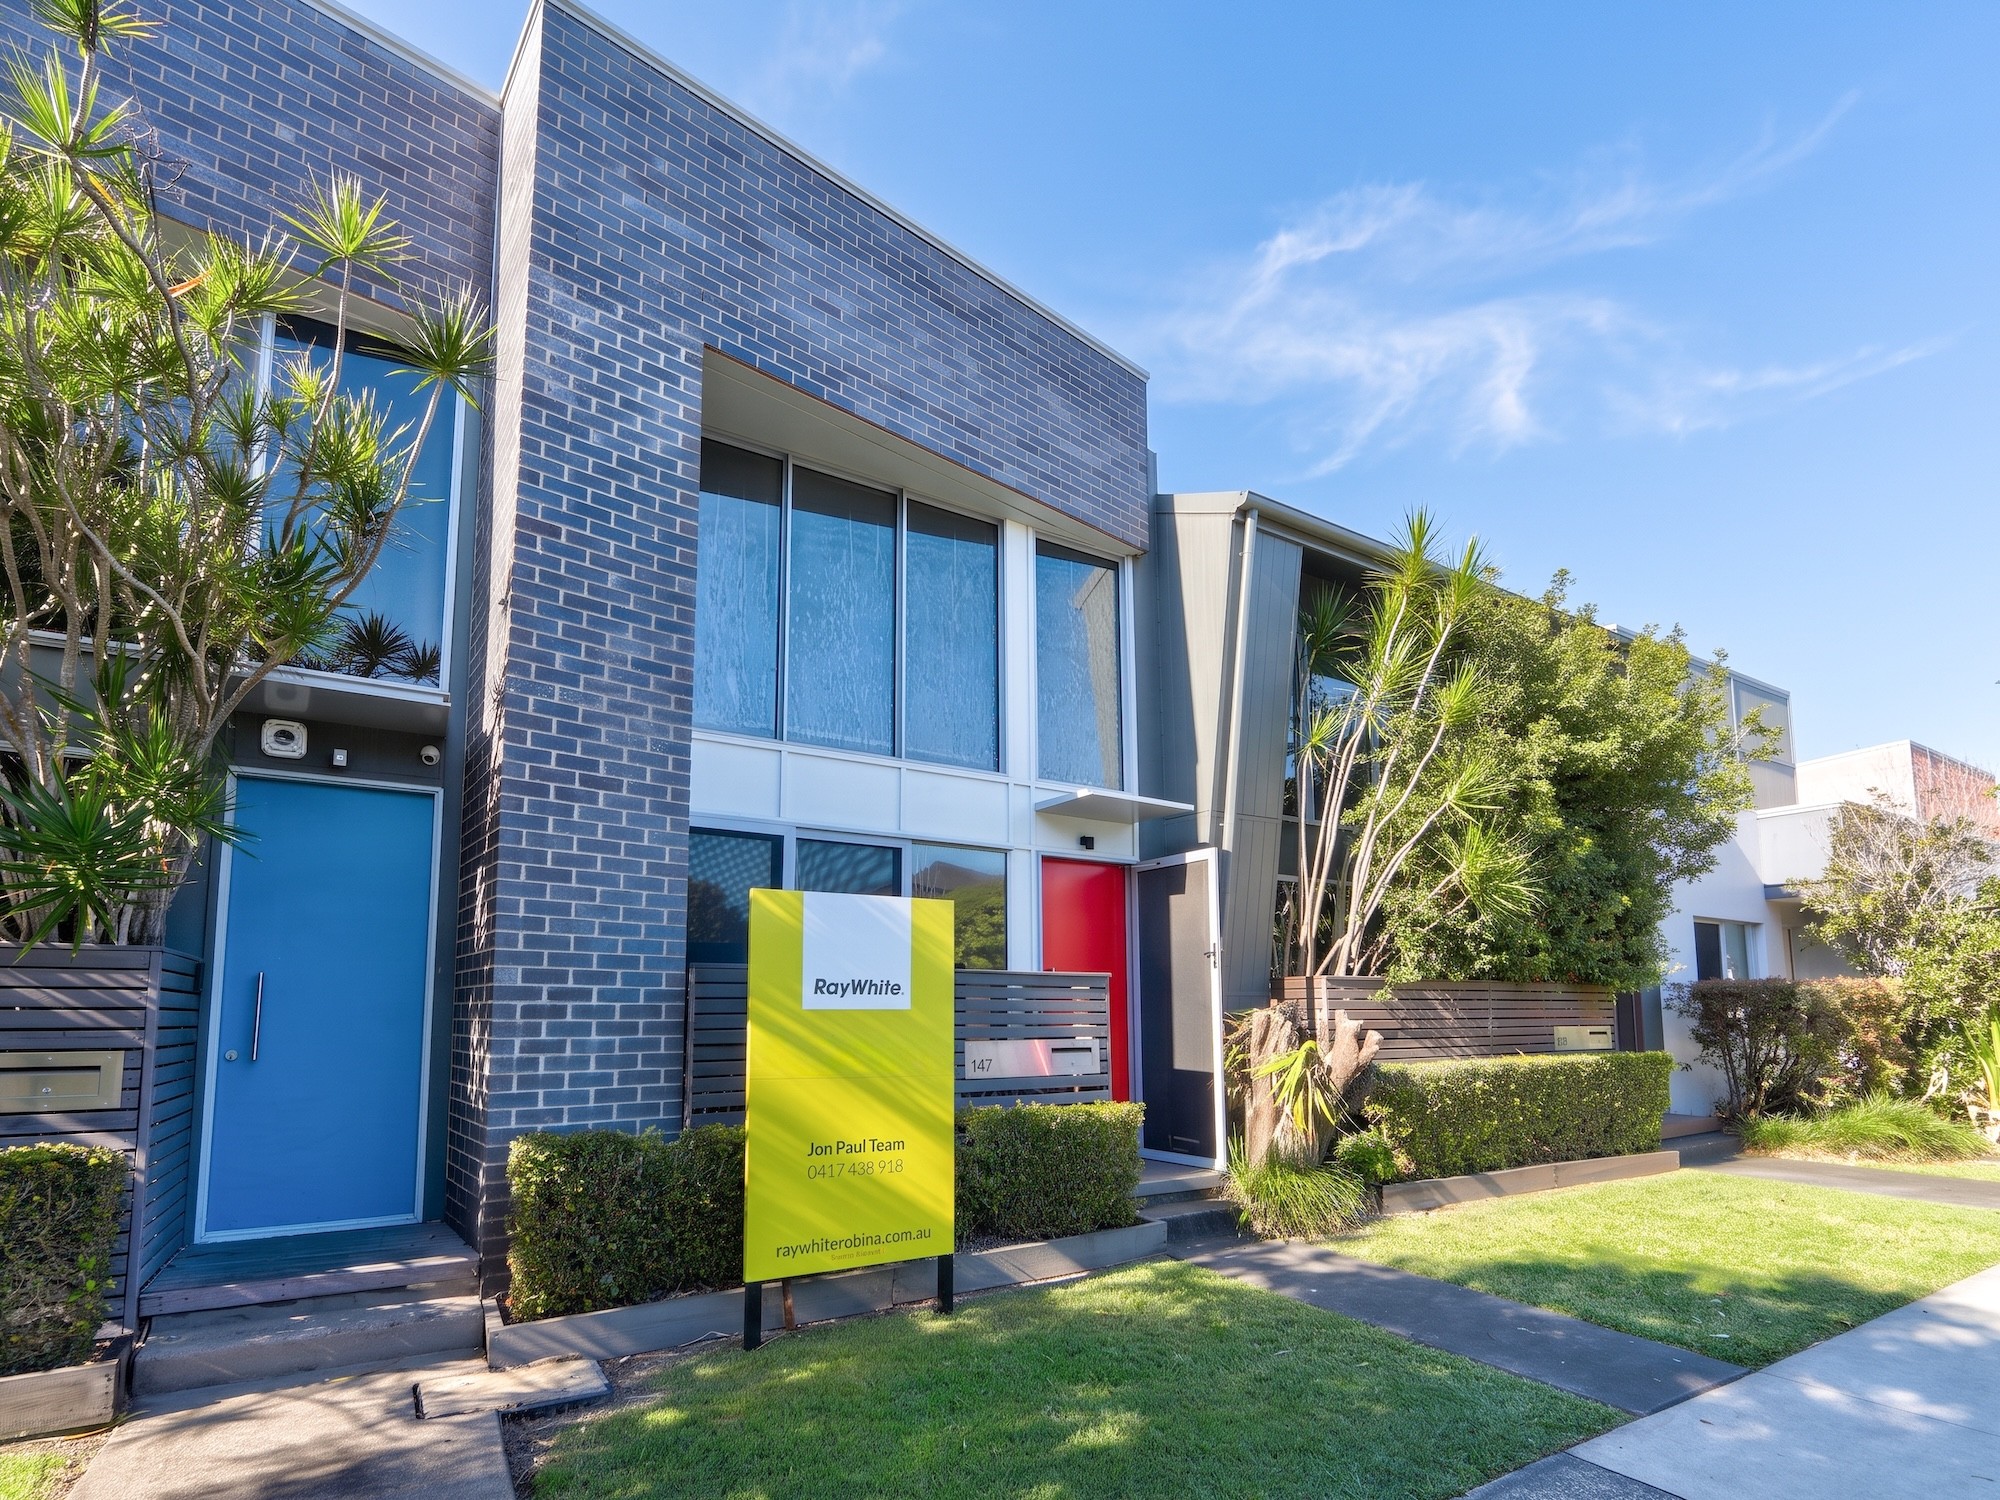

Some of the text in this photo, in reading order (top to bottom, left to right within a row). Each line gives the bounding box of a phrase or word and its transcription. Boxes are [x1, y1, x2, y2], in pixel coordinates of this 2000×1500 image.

[971, 1058, 993, 1073] 147
[807, 1138, 905, 1157] Jon Paul Team
[807, 1158, 904, 1180] 0417 438 918
[775, 1228, 931, 1259] raywhiterobina.com.au
